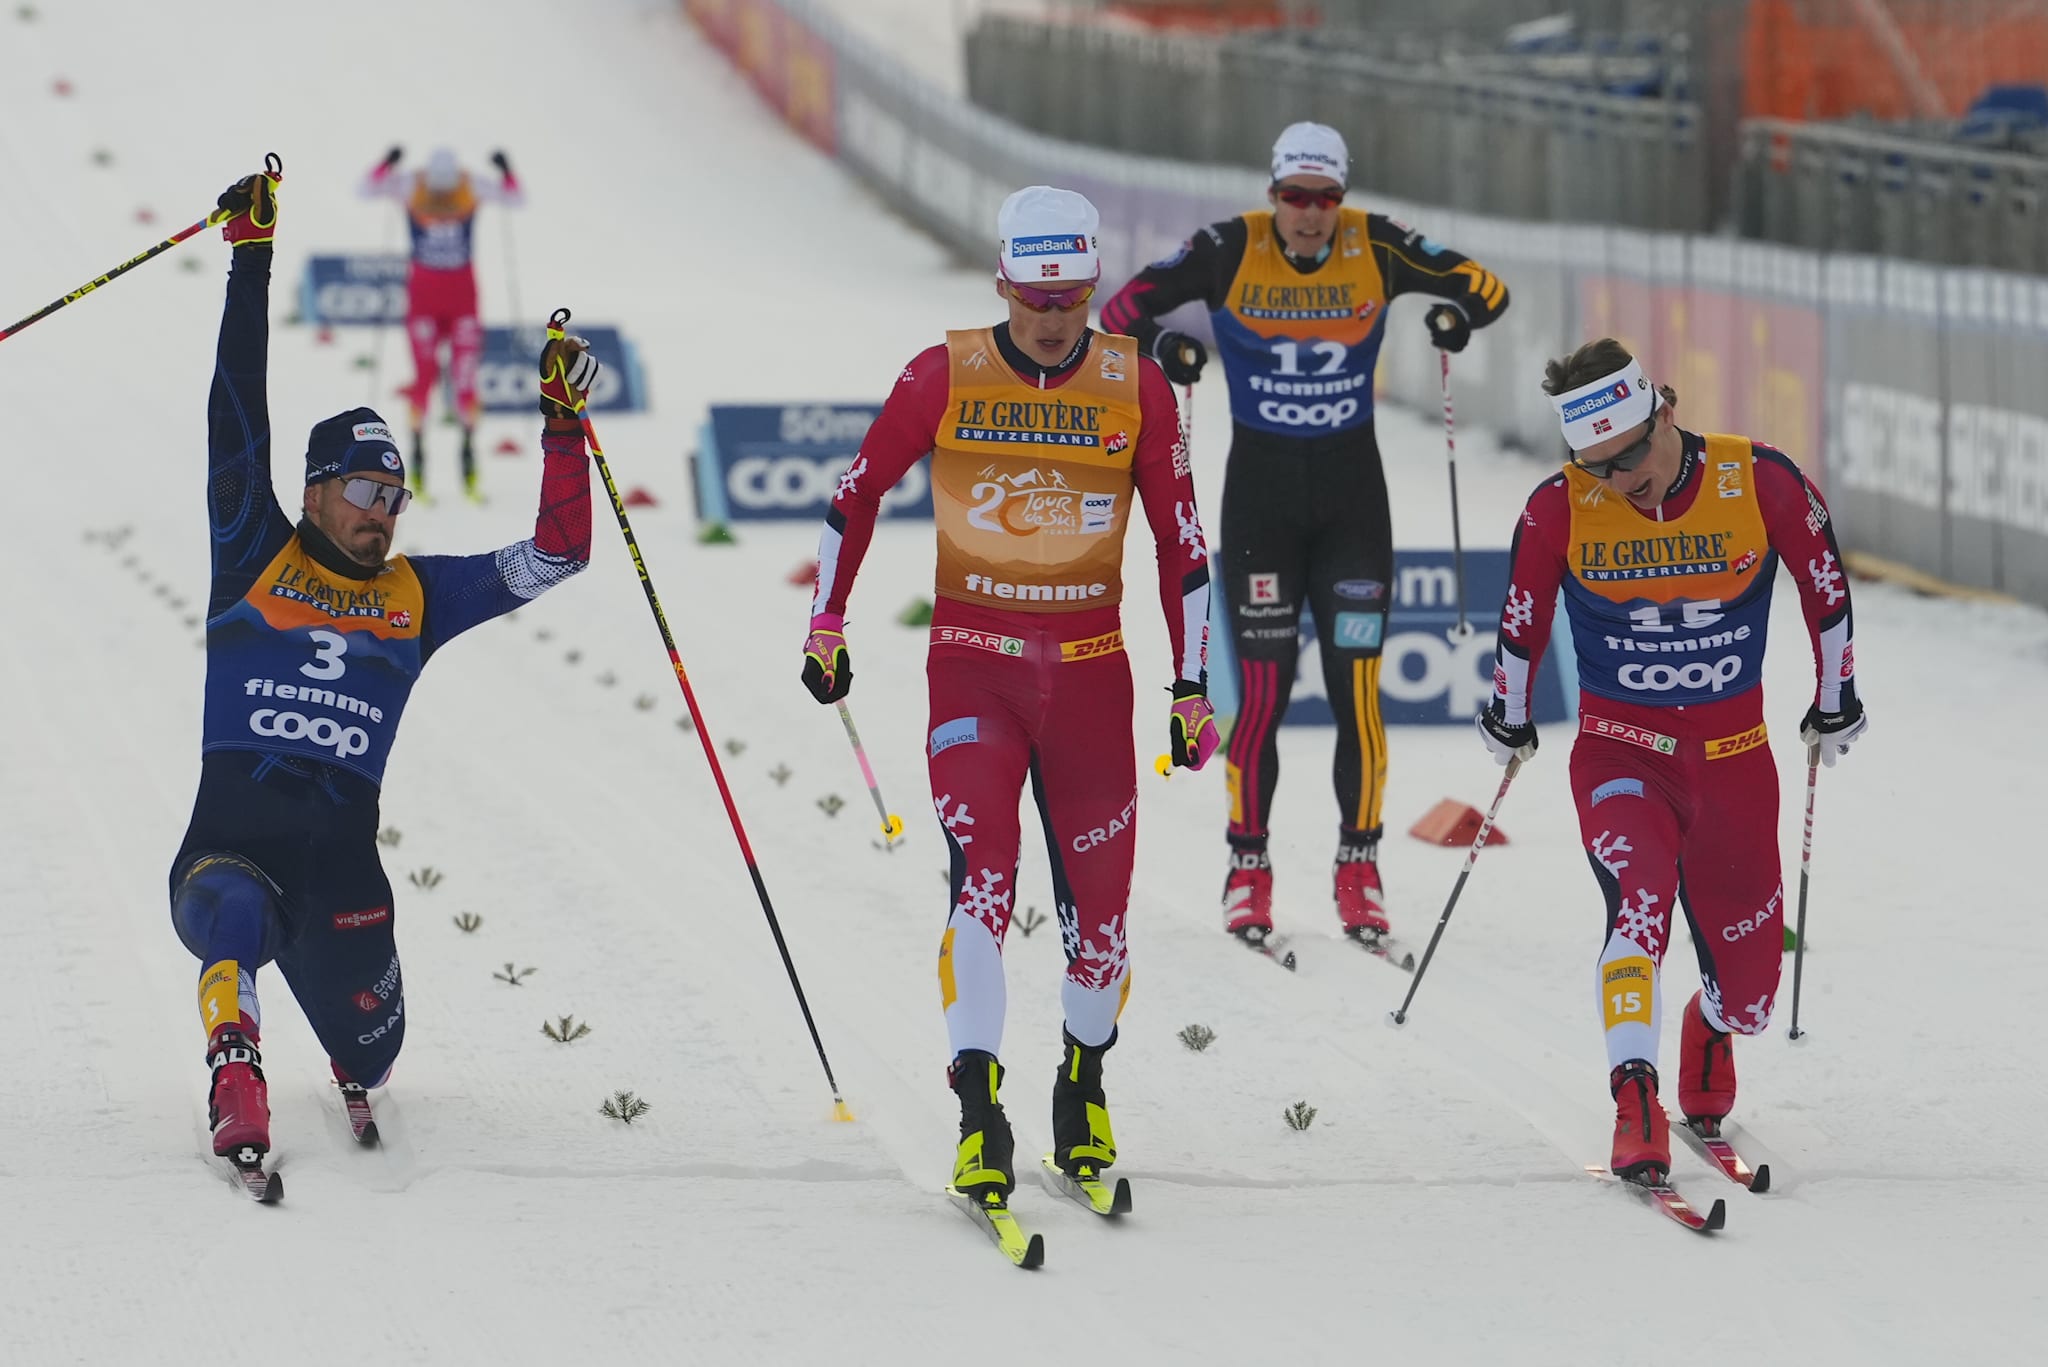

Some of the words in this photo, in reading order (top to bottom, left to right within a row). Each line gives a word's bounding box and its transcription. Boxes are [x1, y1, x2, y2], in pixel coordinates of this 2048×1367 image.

[1013, 240, 1074, 255] SpareBank
[1241, 284, 1263, 306] LE
[1242, 307, 1350, 319] SWITZERLAND
[1271, 342, 1348, 376] 12
[1249, 374, 1365, 396] fiemme
[958, 401, 987, 426] LE
[1259, 399, 1357, 427] coop
[1564, 392, 1616, 420] SpareBank
[961, 430, 1095, 446] SWITZERLAND
[1085, 498, 1112, 509] coop
[1580, 541, 1608, 567] LE
[276, 563, 305, 587] LE
[1587, 562, 1722, 580] SWITZERLAND
[965, 574, 1107, 601] fiemme
[1239, 604, 1294, 618] Kaufland
[1629, 598, 1726, 634] 15
[941, 629, 999, 649] SPAR
[1072, 630, 1124, 658] DHL
[1604, 624, 1752, 653] fiemme
[299, 629, 348, 681] 3
[1618, 655, 1742, 692] coop
[244, 678, 383, 723] fiemme
[1187, 702, 1201, 734] LEKI
[249, 708, 369, 758] coop
[1596, 719, 1654, 747] SPAR
[1717, 729, 1766, 755] DHL
[1072, 800, 1137, 853] CRAFT
[337, 908, 387, 927] VIESSMANN
[1722, 885, 1783, 943] CRAFT
[1612, 992, 1642, 1016] 15
